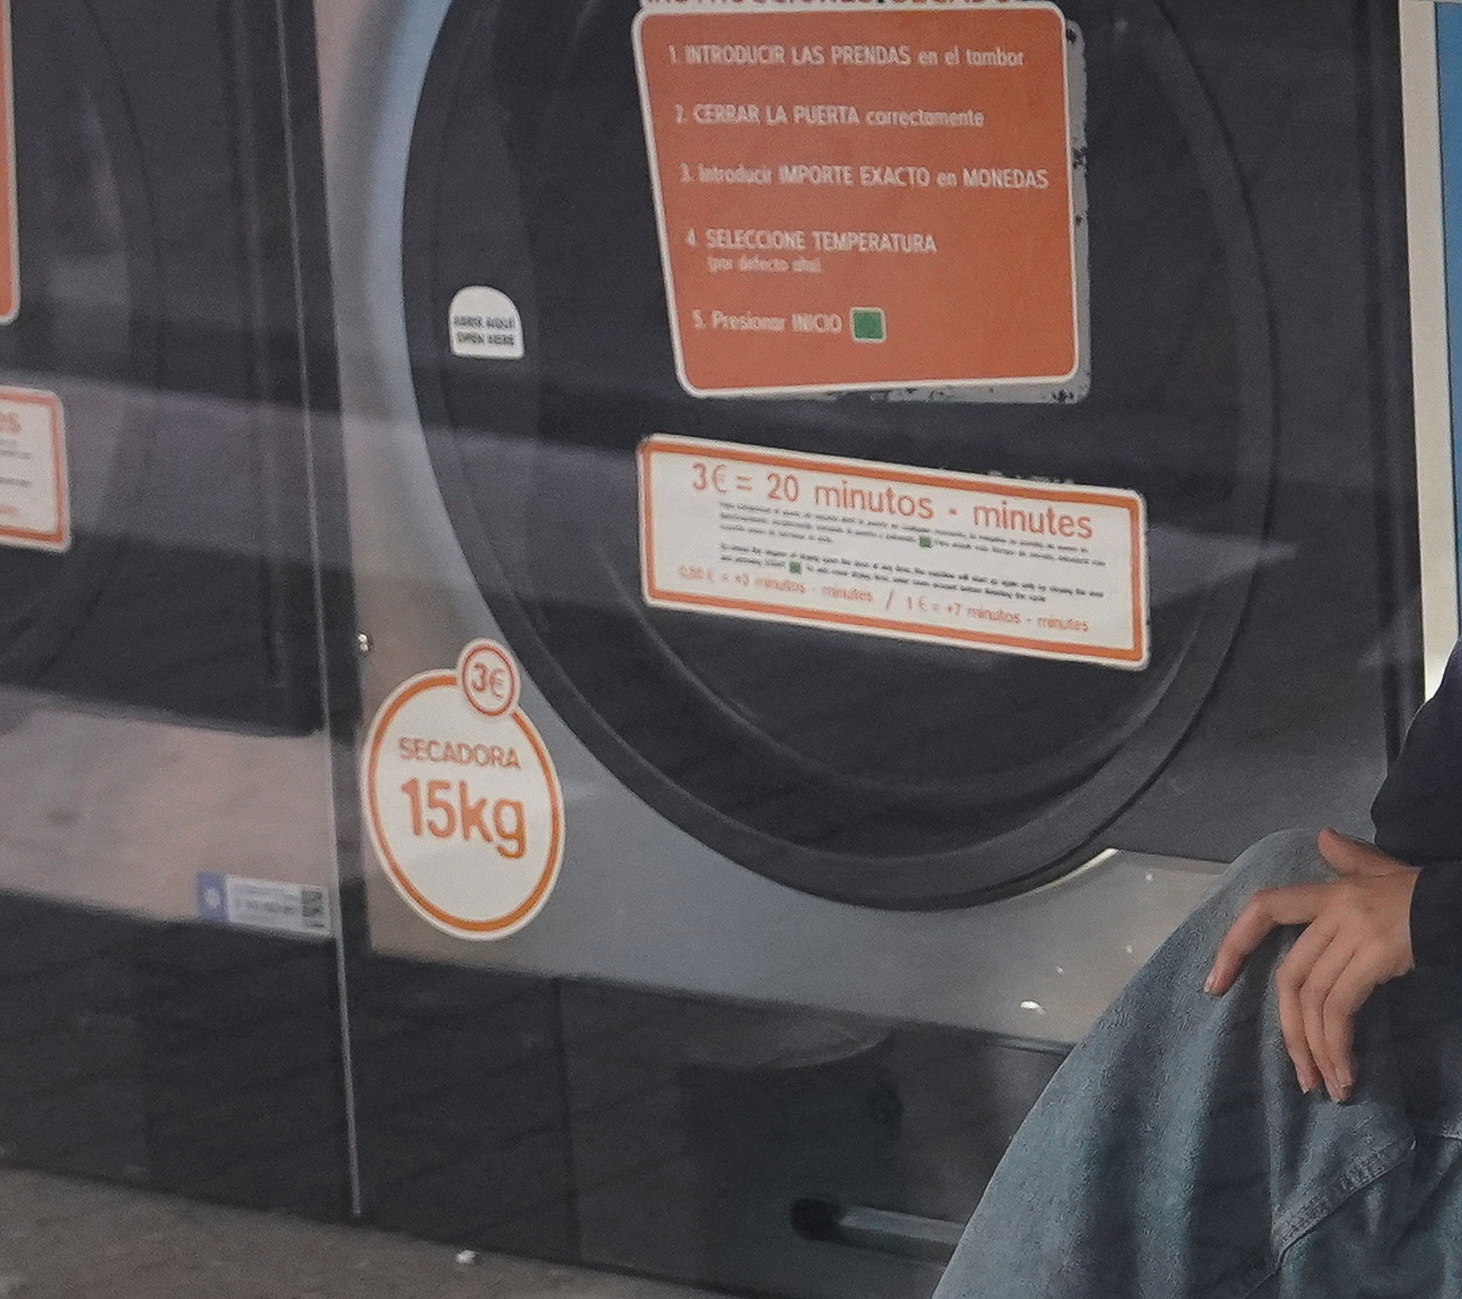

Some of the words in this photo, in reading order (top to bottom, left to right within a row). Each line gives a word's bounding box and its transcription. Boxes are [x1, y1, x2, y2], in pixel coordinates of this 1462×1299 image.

[685, 45, 785, 65] INTRODUCIR
[792, 46, 824, 65] LAS
[831, 45, 912, 66] PRENDAS
[693, 104, 760, 125] CERRAR
[766, 105, 788, 125] LA
[794, 105, 859, 126] PUERTA
[779, 165, 855, 186] IMPORTE
[859, 166, 929, 186] EXACTO
[962, 167, 1049, 189] MONEDAS
[705, 228, 806, 251] SELECCIONE
[812, 231, 938, 253] TEMPERATURA
[691, 462, 729, 495] 3€
[767, 473, 801, 503] 20
[813, 480, 935, 520] minutos
[972, 499, 1094, 540] minutes
[471, 661, 506, 700] 3€
[399, 736, 521, 770] SECADORA
[401, 777, 527, 860] 15kg
